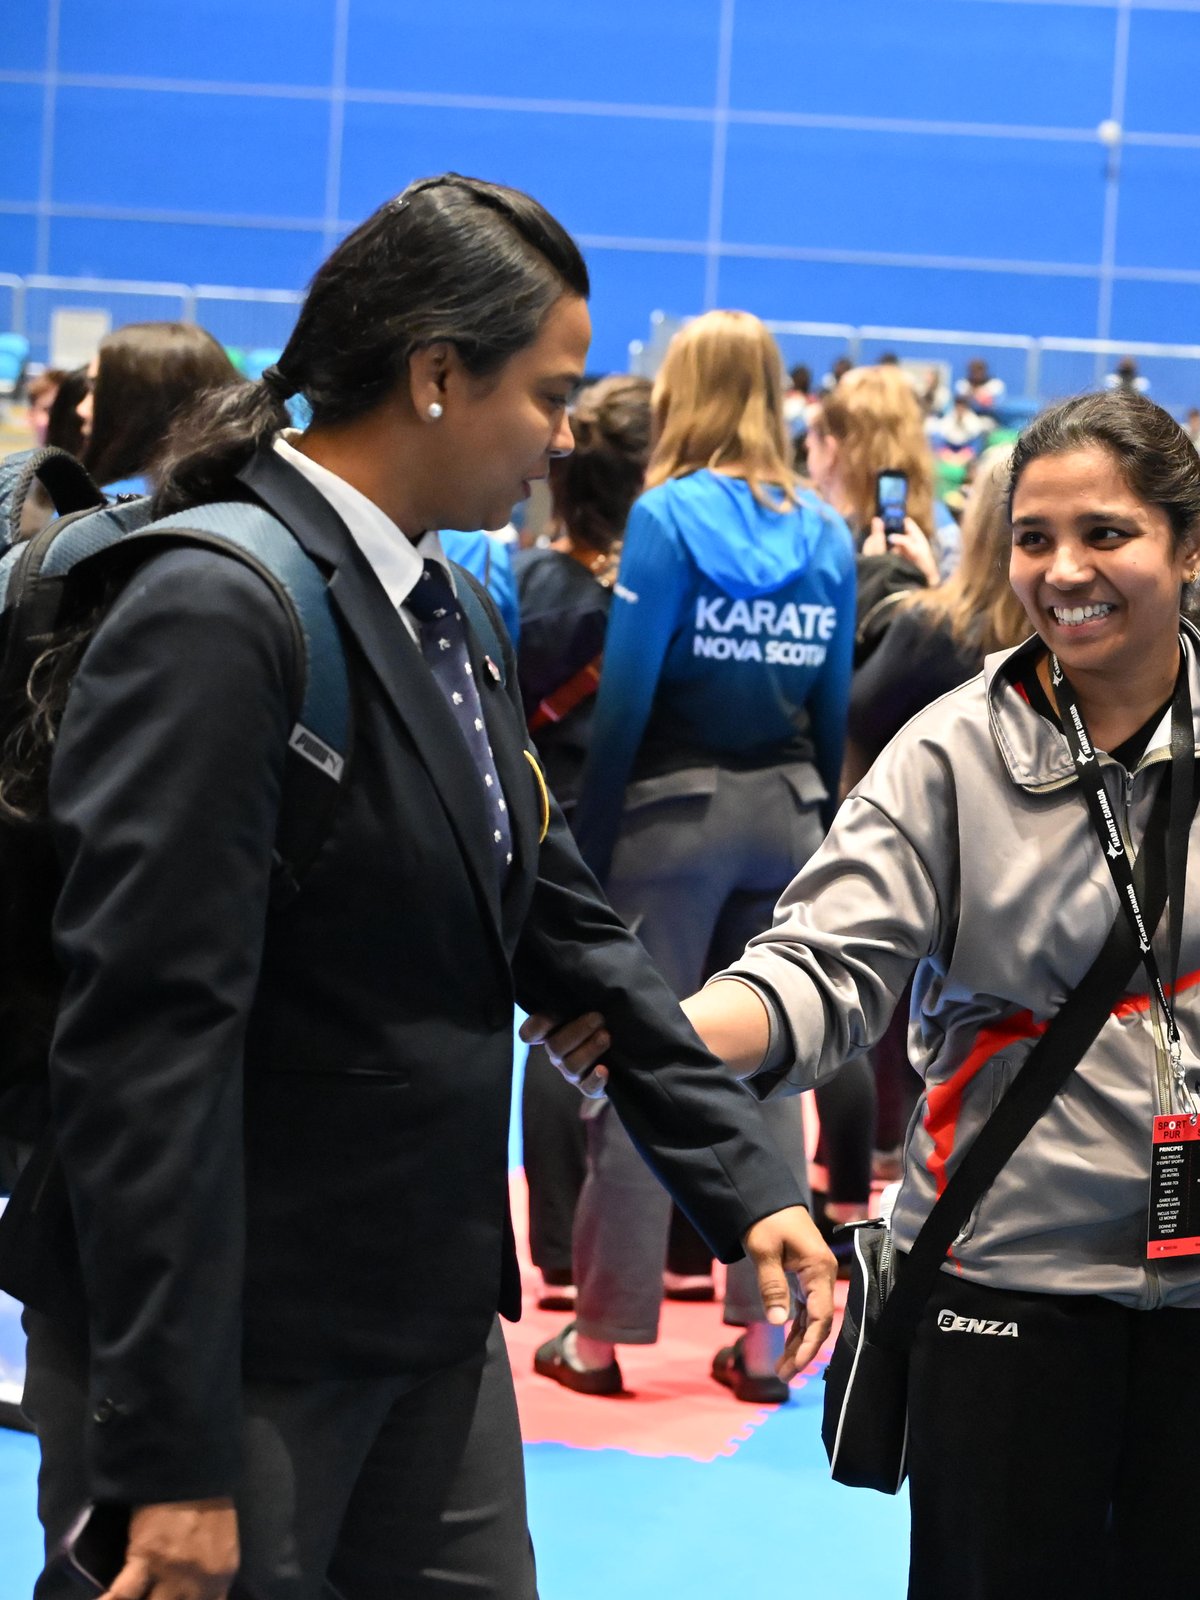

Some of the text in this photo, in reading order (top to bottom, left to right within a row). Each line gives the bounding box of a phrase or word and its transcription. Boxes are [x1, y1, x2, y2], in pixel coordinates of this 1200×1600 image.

[695, 596, 837, 641] KARATE
[693, 635, 763, 662] NOVA
[1069, 704, 1092, 755] KARATE CANADA
[1096, 788, 1121, 848] KARATE CANADA
[1126, 883, 1148, 943] KARATE CANADA
[1158, 1120, 1187, 1130] SPORT
[1164, 1130, 1180, 1139] PUR
[937, 1309, 1019, 1337] BENZA
